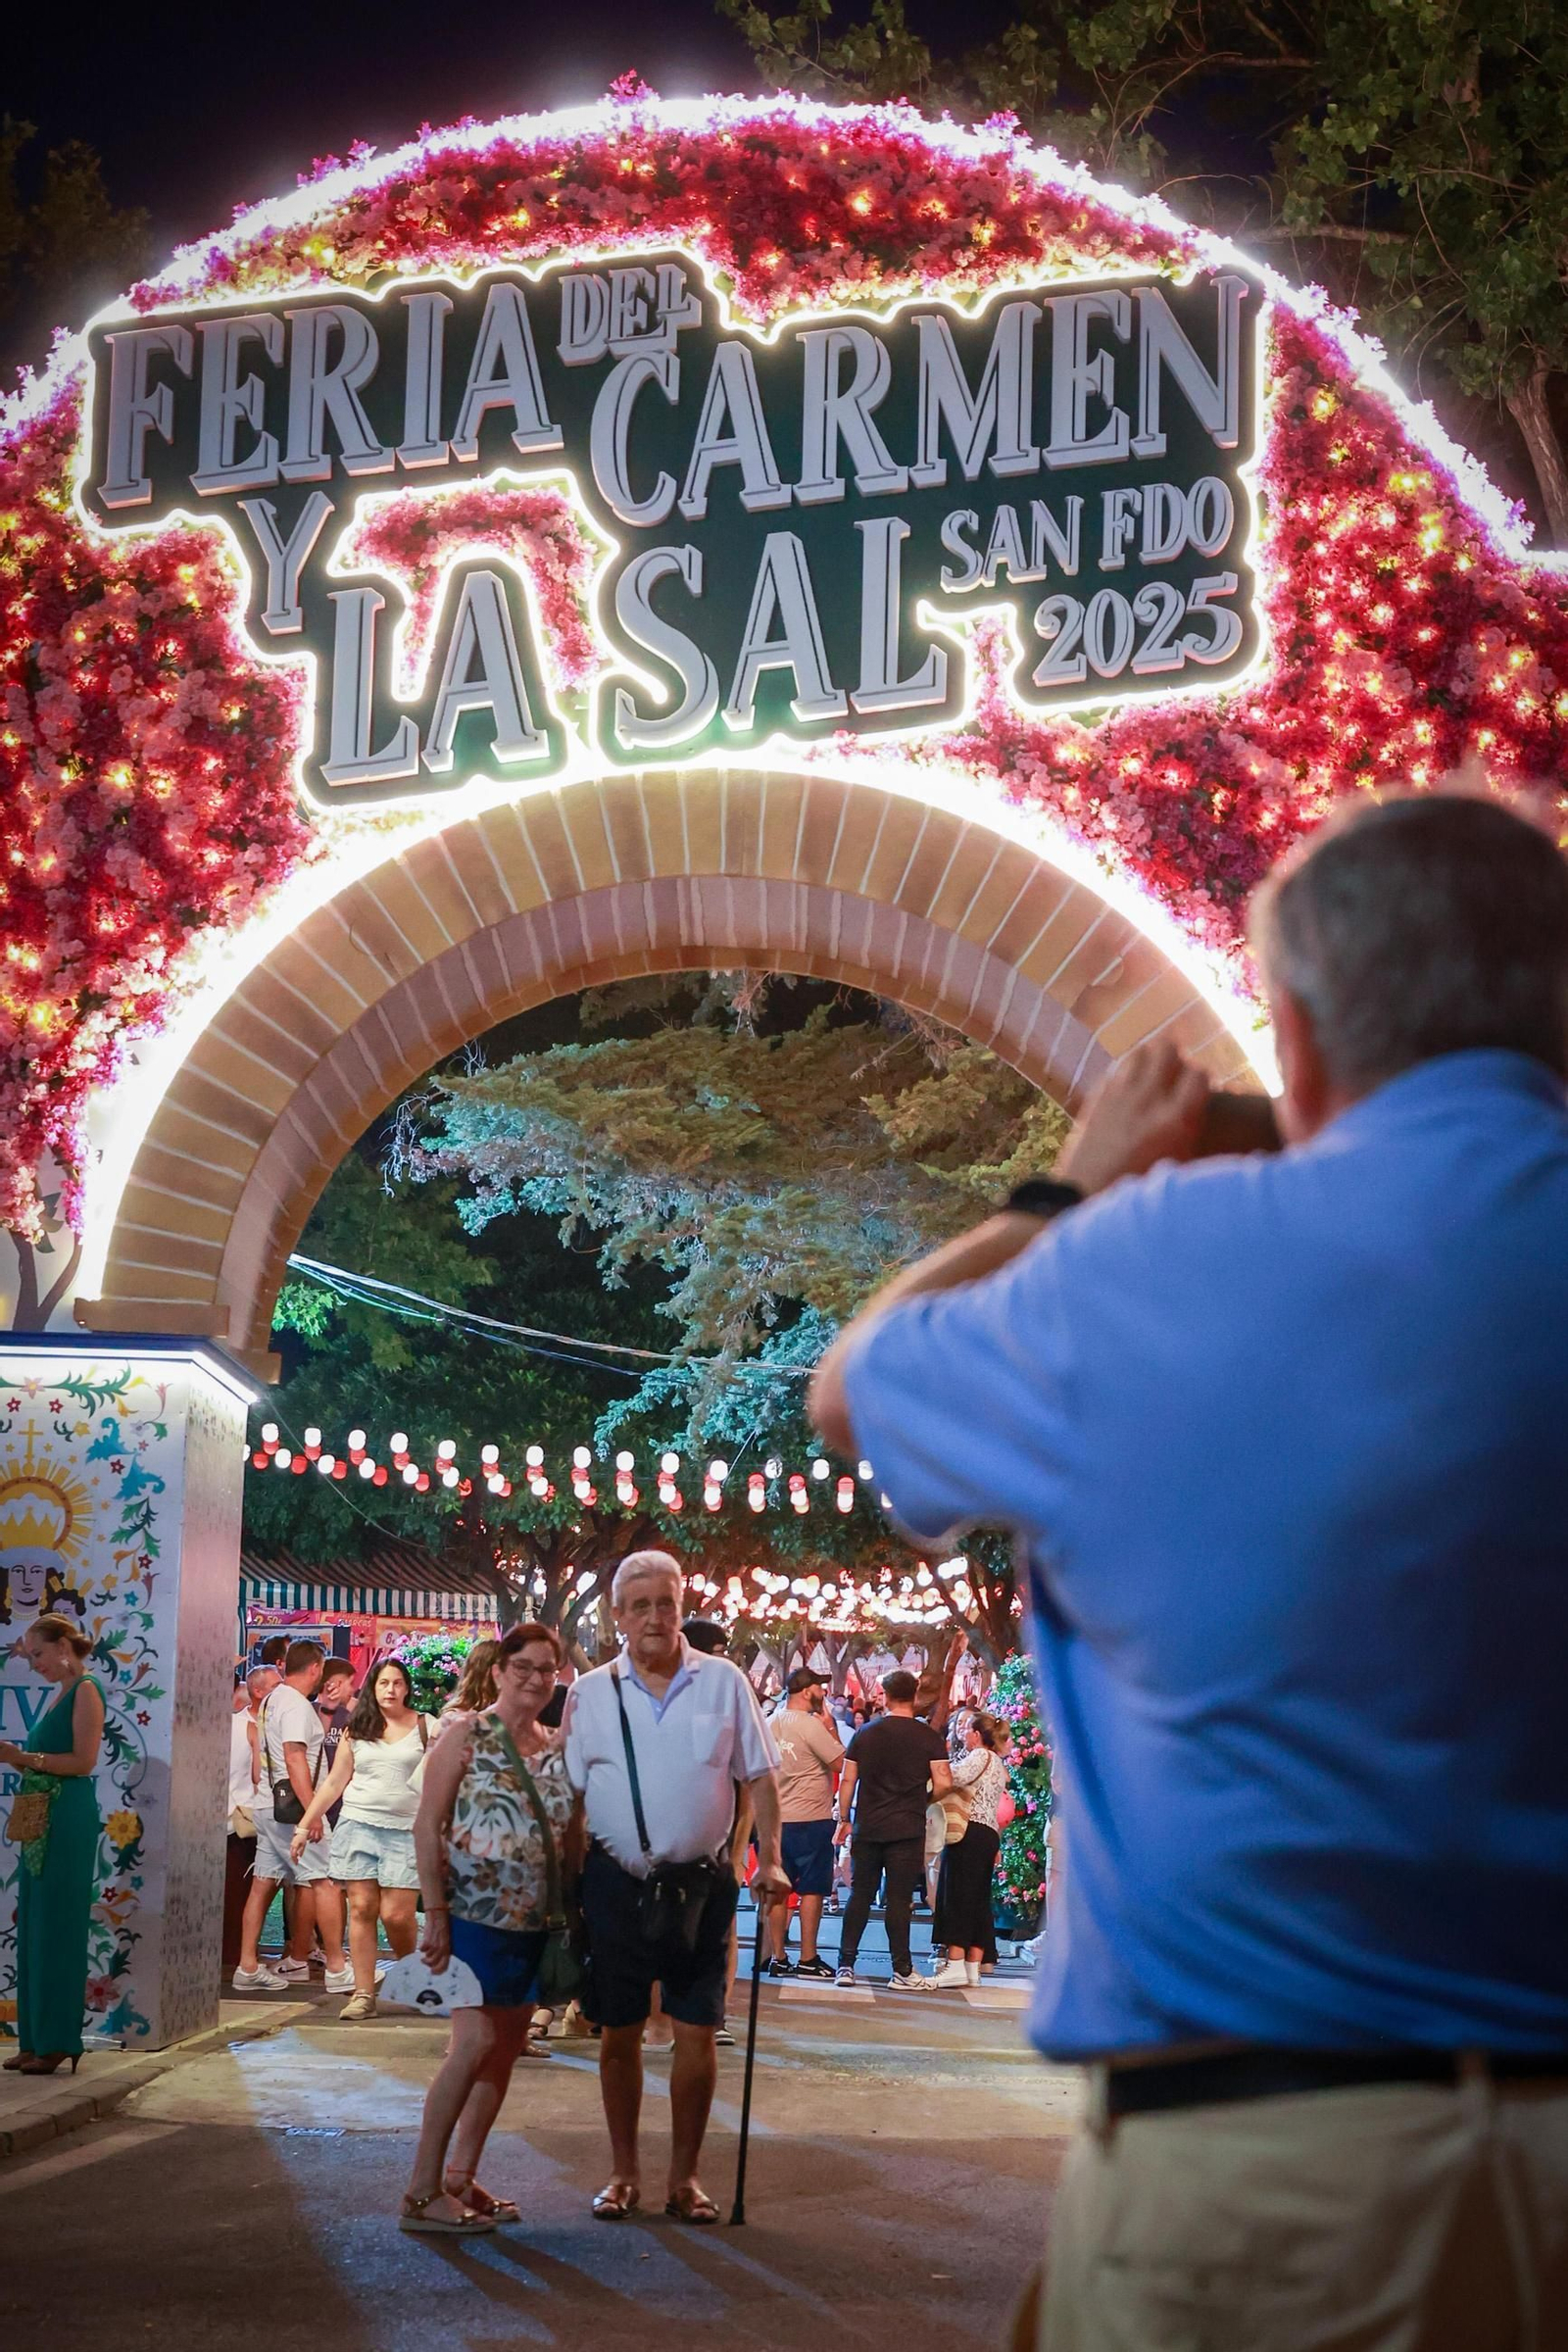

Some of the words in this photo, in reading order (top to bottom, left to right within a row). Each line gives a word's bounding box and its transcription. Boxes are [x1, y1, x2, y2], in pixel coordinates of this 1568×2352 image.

[556, 264, 702, 367] DEL
[98, 283, 564, 509] FERIA
[591, 274, 1250, 527] CARMEN
[237, 491, 334, 634] Y
[941, 495, 1084, 593] SAN
[1098, 476, 1234, 572] FDO
[319, 570, 549, 787] LA
[614, 516, 947, 751] SAL
[1033, 571, 1243, 687] 2025
